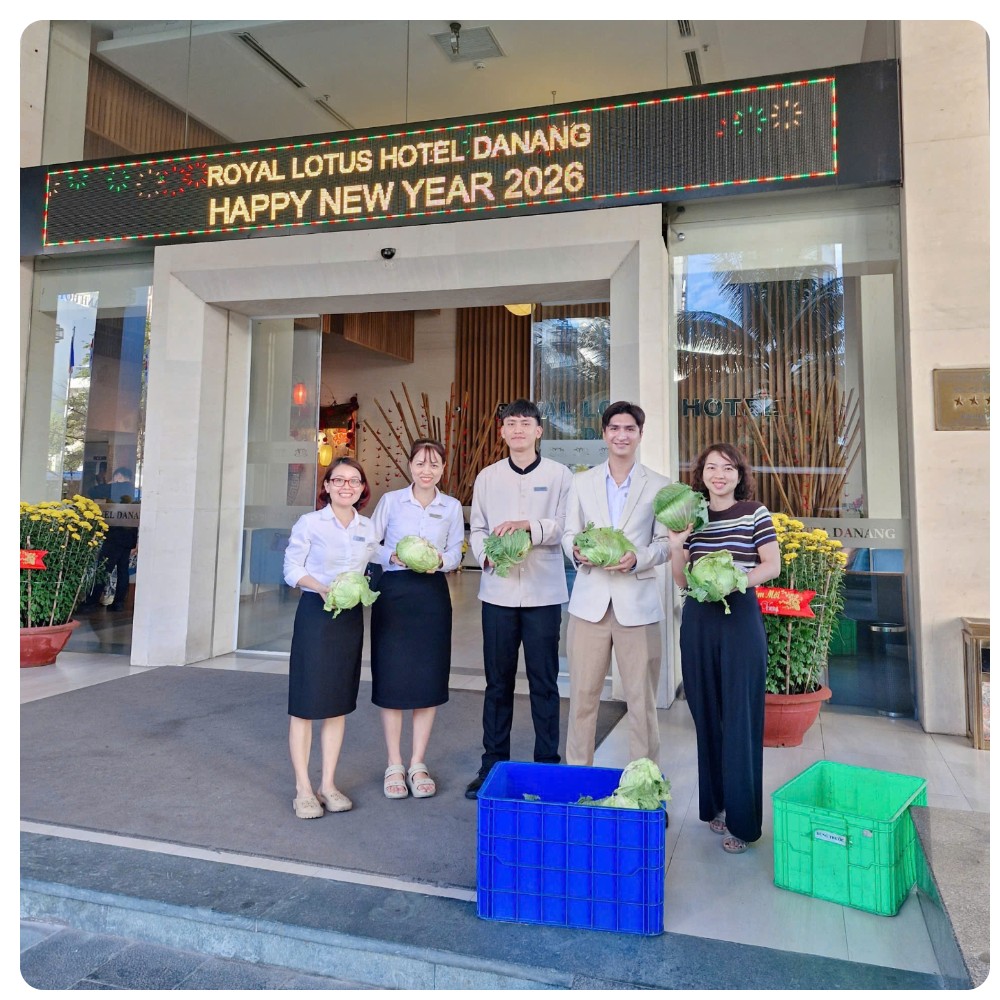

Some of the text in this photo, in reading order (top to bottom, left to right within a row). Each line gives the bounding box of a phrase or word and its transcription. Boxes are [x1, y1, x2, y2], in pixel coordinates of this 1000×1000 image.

[207, 122, 591, 187] ROYAL LOTUS HOTEL DANANG
[209, 161, 586, 226] HAPPY NEW YEAR 2026
[833, 527, 896, 540] DANANG
